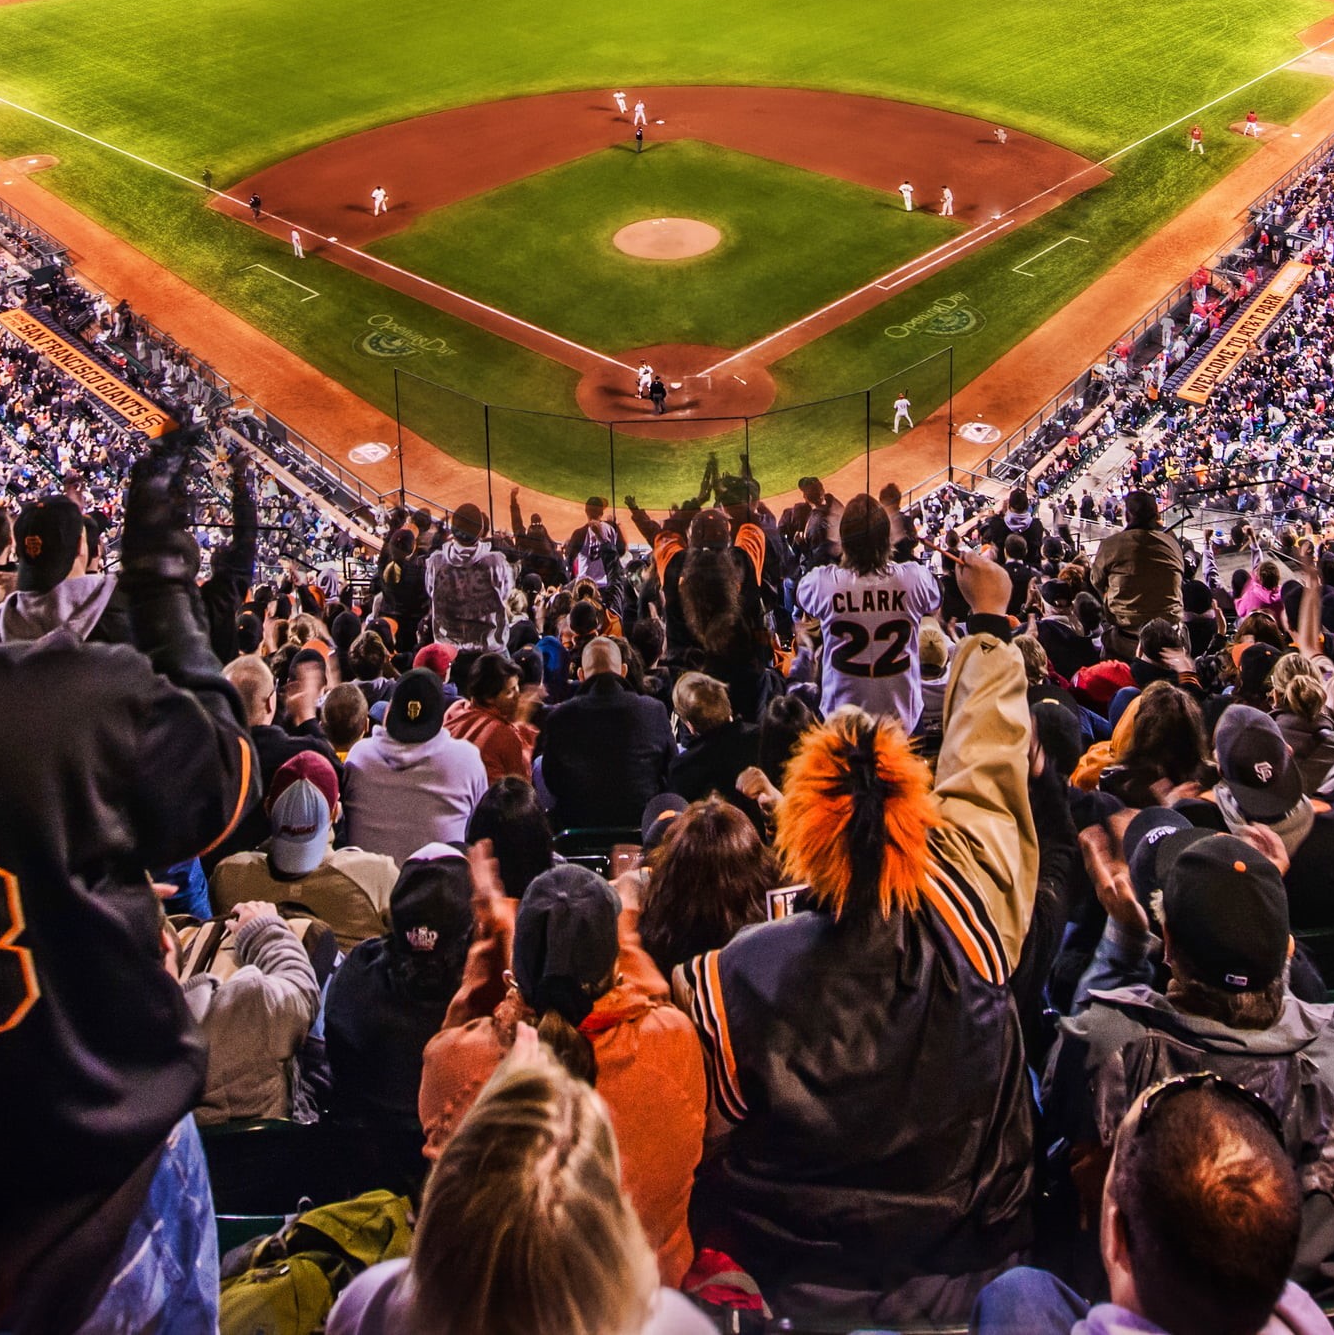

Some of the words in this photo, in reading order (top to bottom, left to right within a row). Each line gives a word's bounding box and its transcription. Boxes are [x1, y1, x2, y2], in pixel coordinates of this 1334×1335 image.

[367, 314, 428, 346] Opening
[420, 338, 458, 358] Day
[884, 298, 950, 339] Opening
[940, 291, 970, 314] Day
[17, 324, 46, 346] SAN
[40, 340, 104, 384] FRANCISCO
[94, 381, 148, 417] GIANTS
[1188, 348, 1237, 394] WELCOME
[1226, 336, 1247, 349] TO
[1238, 314, 1266, 336] AT&T
[1256, 294, 1284, 316] PARK
[832, 589, 907, 614] CLARK
[830, 618, 912, 678] 22
